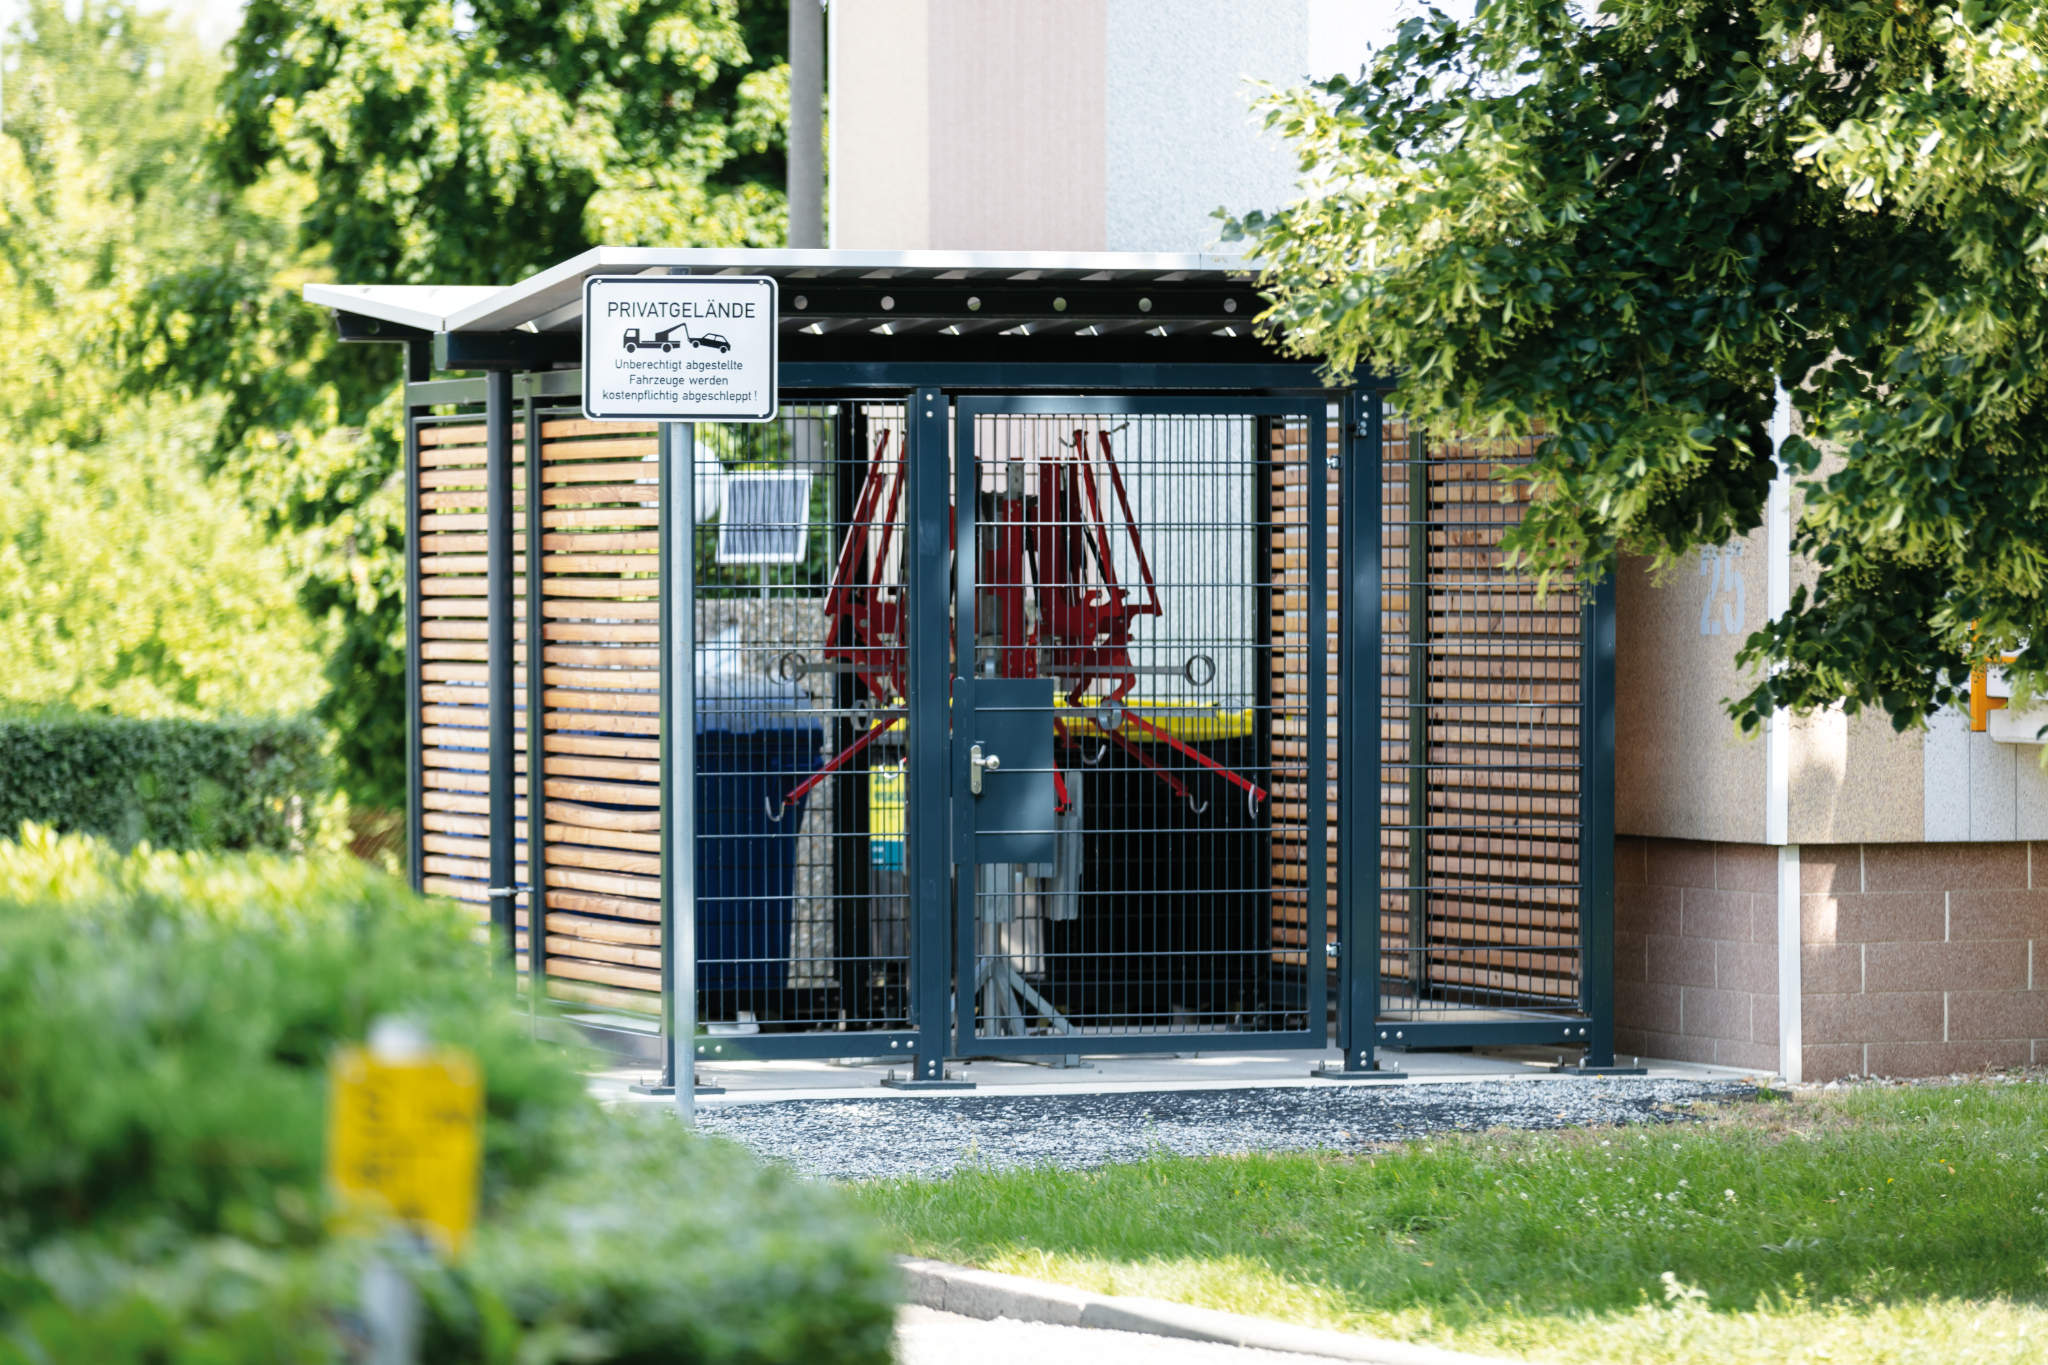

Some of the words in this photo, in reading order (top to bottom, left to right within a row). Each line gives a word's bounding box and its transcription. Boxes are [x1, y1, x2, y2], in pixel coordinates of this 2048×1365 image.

[607, 299, 756, 319] PRIVATGELÄNDE
[615, 359, 682, 371] Unberechtigt
[686, 360, 743, 372] abgestellte
[629, 374, 685, 387] Fahrzeuge
[689, 376, 728, 386] werden
[602, 390, 679, 403] kostenpflichtig
[1700, 542, 1744, 635] 25
